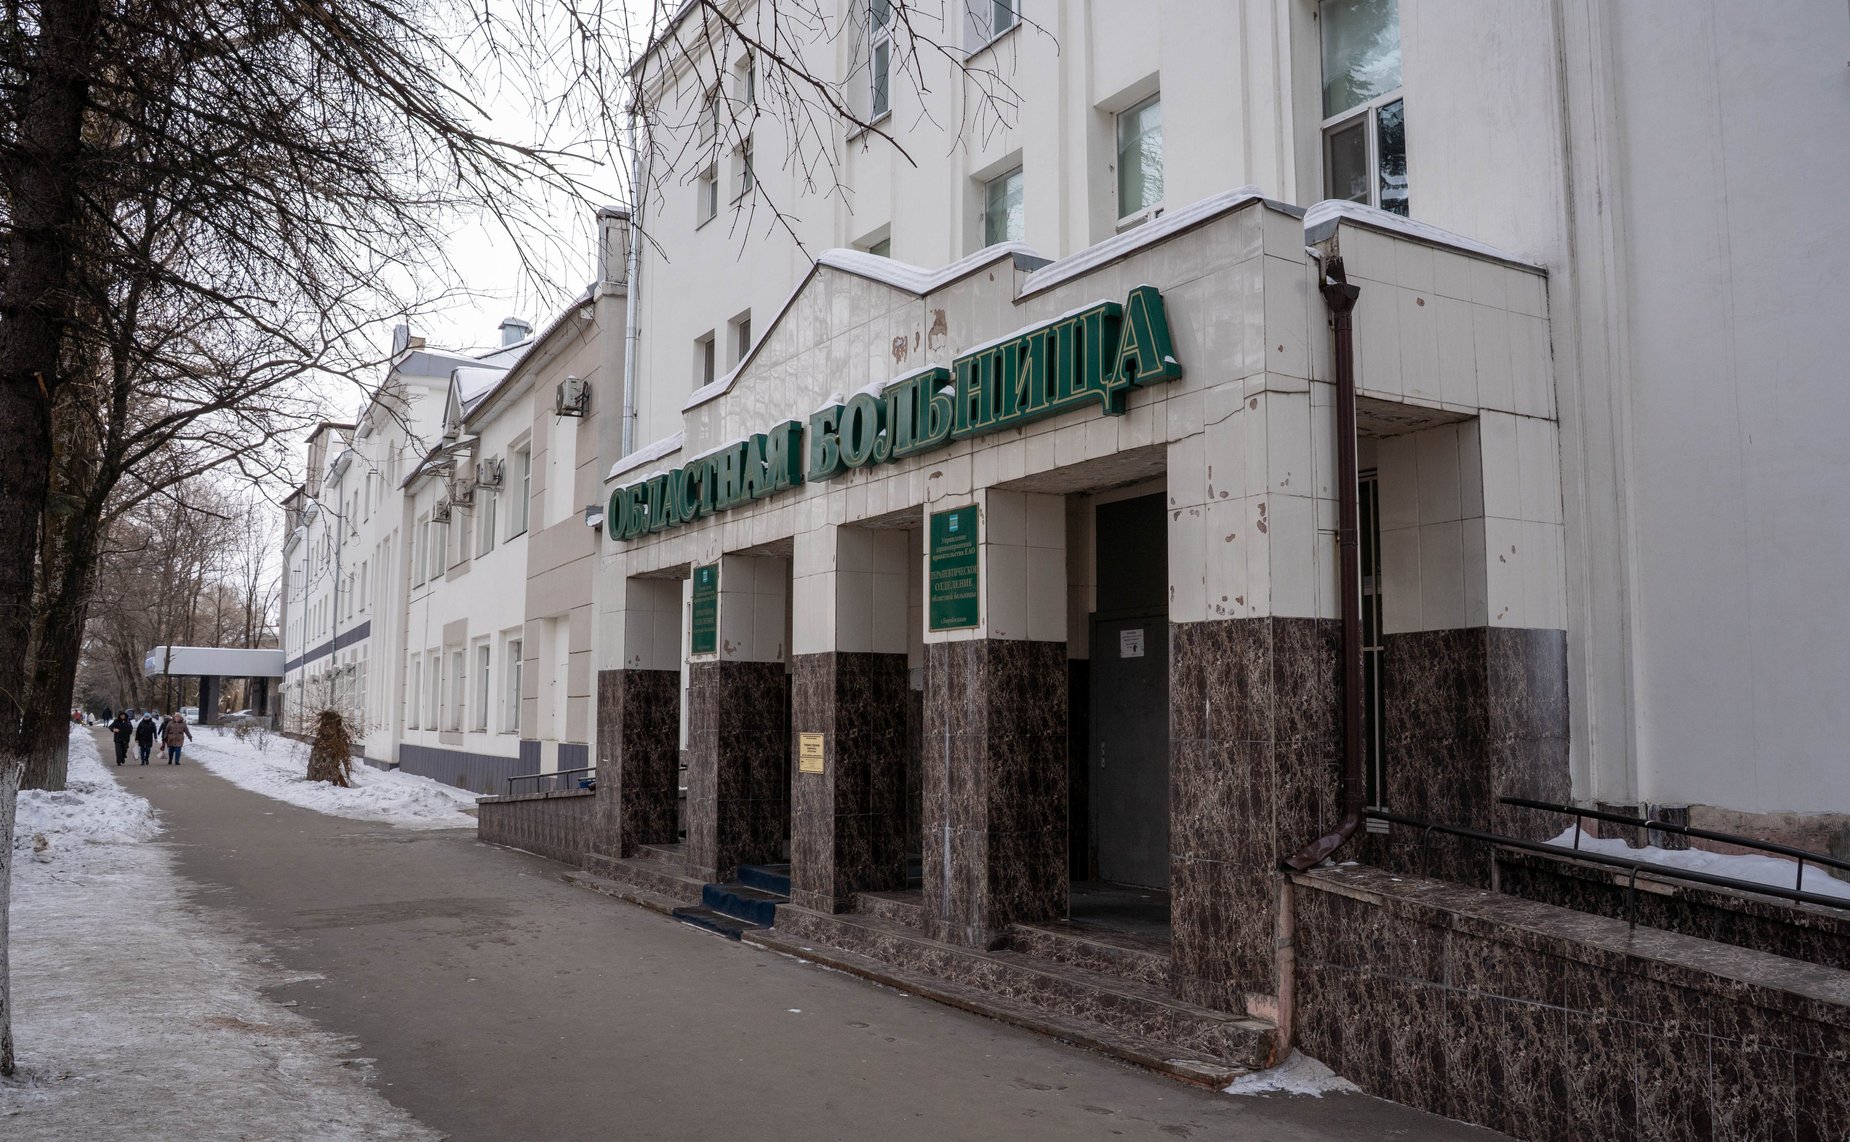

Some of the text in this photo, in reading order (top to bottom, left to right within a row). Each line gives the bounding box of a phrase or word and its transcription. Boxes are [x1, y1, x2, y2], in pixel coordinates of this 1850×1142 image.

[608, 285, 1181, 541] ОБЛАСТНАЯ БОЛЬНИЦА
[964, 547, 976, 556] ЕАО
[934, 578, 974, 592] ОТДЕЛЕНИЕ
